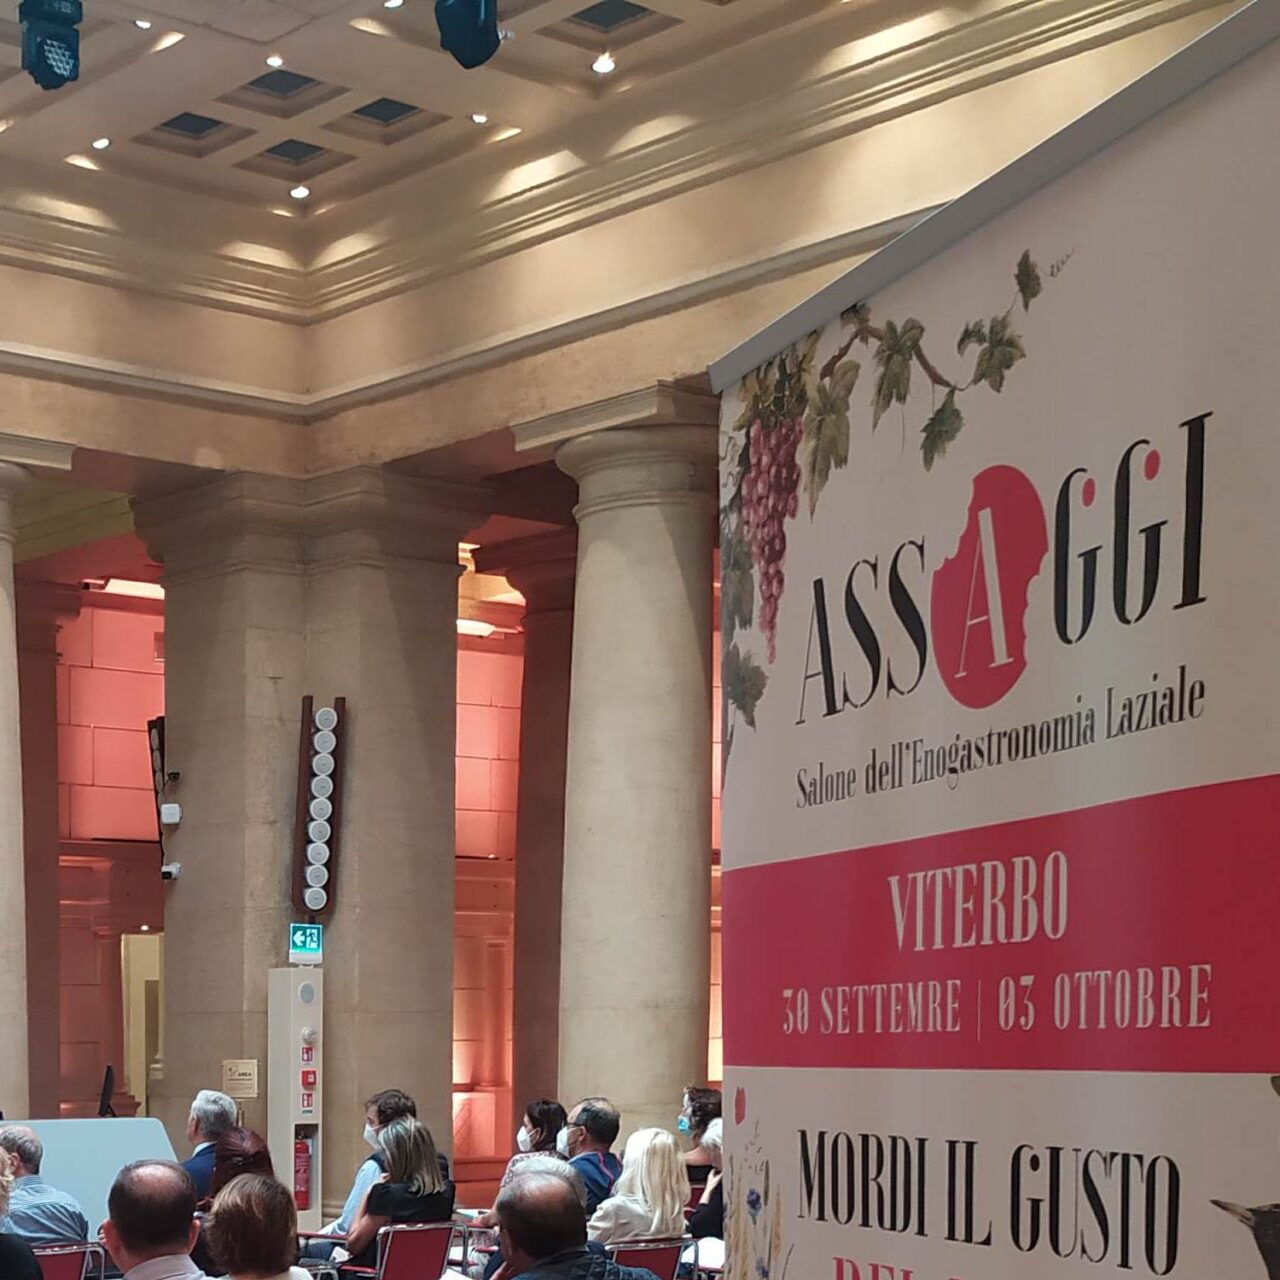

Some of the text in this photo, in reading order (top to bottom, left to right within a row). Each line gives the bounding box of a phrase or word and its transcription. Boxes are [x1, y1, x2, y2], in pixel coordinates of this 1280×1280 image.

[795, 411, 1213, 726] ASSAGGI
[796, 665, 1206, 809] Salone dell'Enogastronomia Laziale
[888, 850, 1070, 954] VITERBO
[782, 964, 1213, 1036] 30 SETTEMRE 03 OTTOBRE
[796, 1129, 1182, 1277] MORDI IL GUSTO
